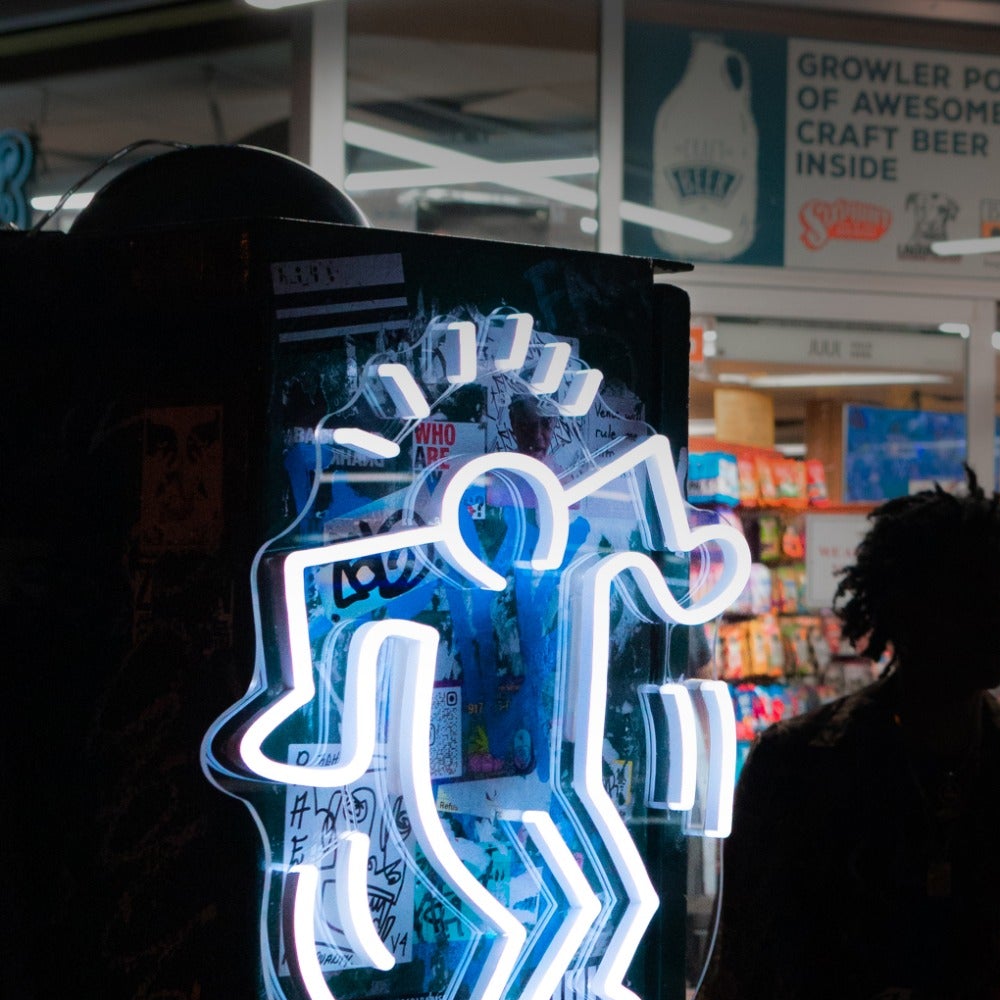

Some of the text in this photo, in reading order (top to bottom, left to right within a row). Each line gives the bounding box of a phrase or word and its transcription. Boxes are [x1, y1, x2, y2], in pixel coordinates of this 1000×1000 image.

[796, 53, 950, 88] GROWLER
[796, 86, 839, 112] OF
[796, 120, 988, 157] CRAFT BEER
[795, 151, 898, 181] INSIDE
[671, 166, 736, 199] BEER
[415, 422, 455, 446] WHO
[415, 446, 451, 470] ARE
